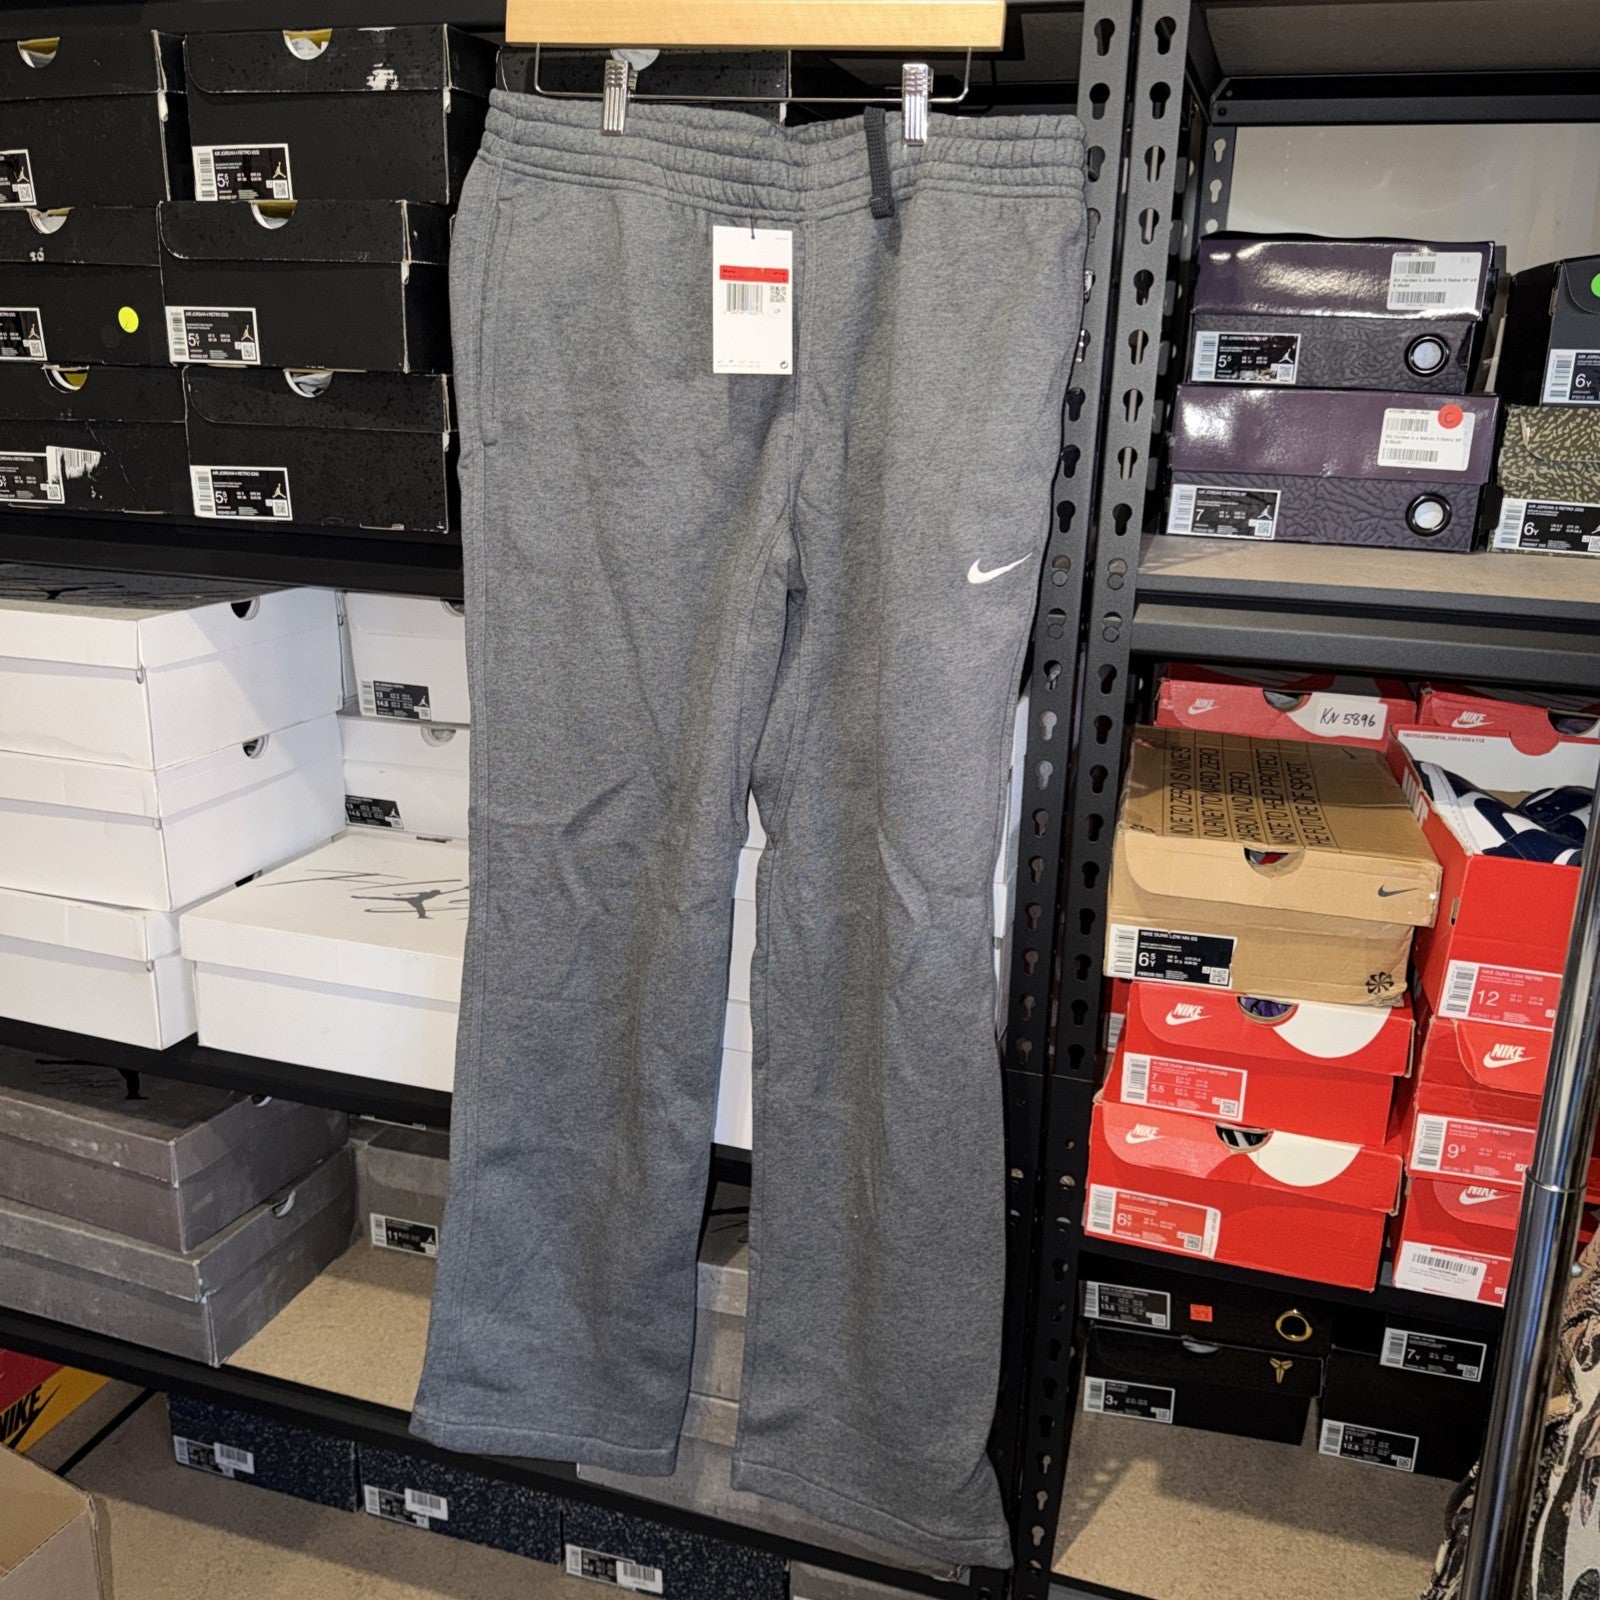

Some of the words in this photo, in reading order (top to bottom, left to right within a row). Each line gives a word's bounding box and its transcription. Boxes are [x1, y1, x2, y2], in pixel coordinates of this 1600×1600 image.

[1196, 509, 1205, 521] 7
[1194, 698, 1215, 707] NIKE
[1343, 712, 1376, 727] 5896
[1459, 711, 1487, 722] NIKE
[1199, 748, 1220, 770] ZERO
[1256, 749, 1280, 788] PROTECT
[1200, 772, 1222, 806] TOWARD
[1229, 772, 1252, 796] ZERO
[1170, 783, 1192, 805] ZERO
[1261, 788, 1284, 810] HELP
[1293, 791, 1316, 805] OF
[1171, 805, 1192, 815] TO
[1231, 797, 1254, 815] AND
[1295, 805, 1324, 834] FUTURE
[1477, 990, 1500, 1006] 12
[1174, 1003, 1204, 1017] NIKE
[1491, 1044, 1526, 1060] NIKE
[1151, 1084, 1165, 1093] 5.5
[1132, 1123, 1159, 1138] NIKE
